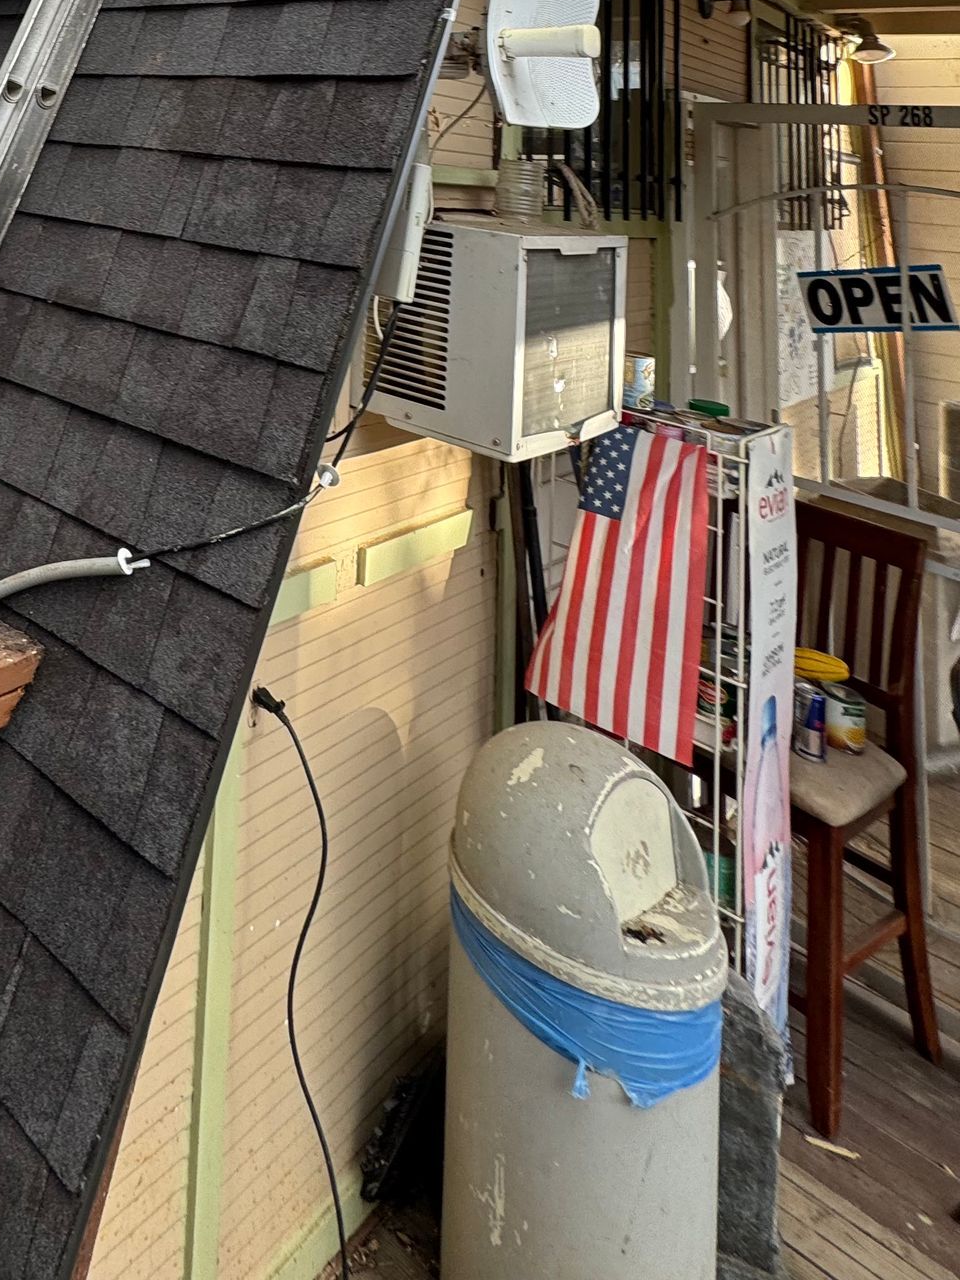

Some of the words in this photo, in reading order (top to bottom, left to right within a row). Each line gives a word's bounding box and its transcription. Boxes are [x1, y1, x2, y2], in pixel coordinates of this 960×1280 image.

[868, 104, 890, 126] SP
[899, 105, 934, 127] 268
[806, 273, 954, 326] OPEN
